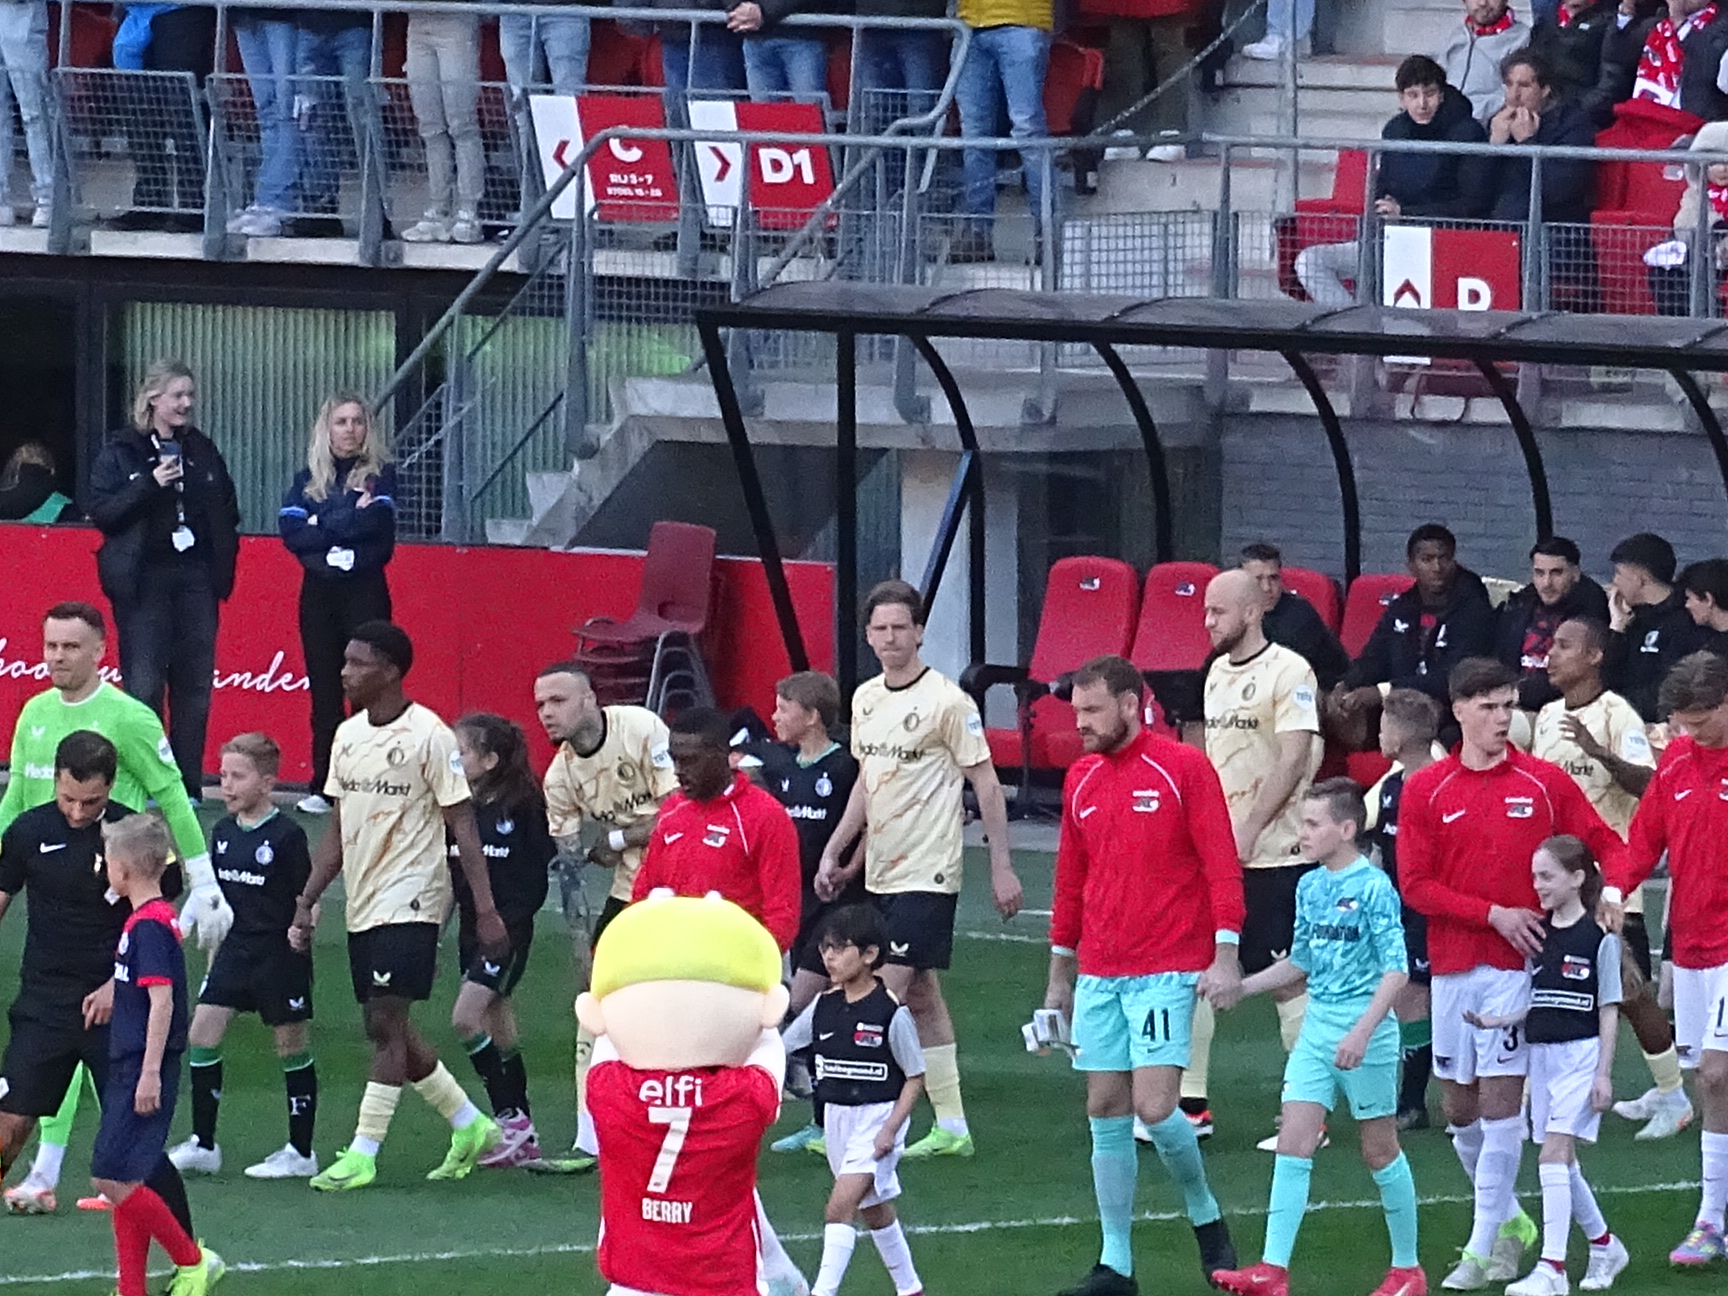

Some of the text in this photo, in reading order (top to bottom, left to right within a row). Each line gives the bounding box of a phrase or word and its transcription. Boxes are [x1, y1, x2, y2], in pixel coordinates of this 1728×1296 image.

[758, 148, 816, 185] D1
[1458, 277, 1491, 311] D
[1141, 1007, 1171, 1042] 41
[290, 1093, 311, 1116] F
[638, 1075, 703, 1107] elfi
[648, 1106, 693, 1194] 7
[642, 1197, 693, 1224] BERRY
